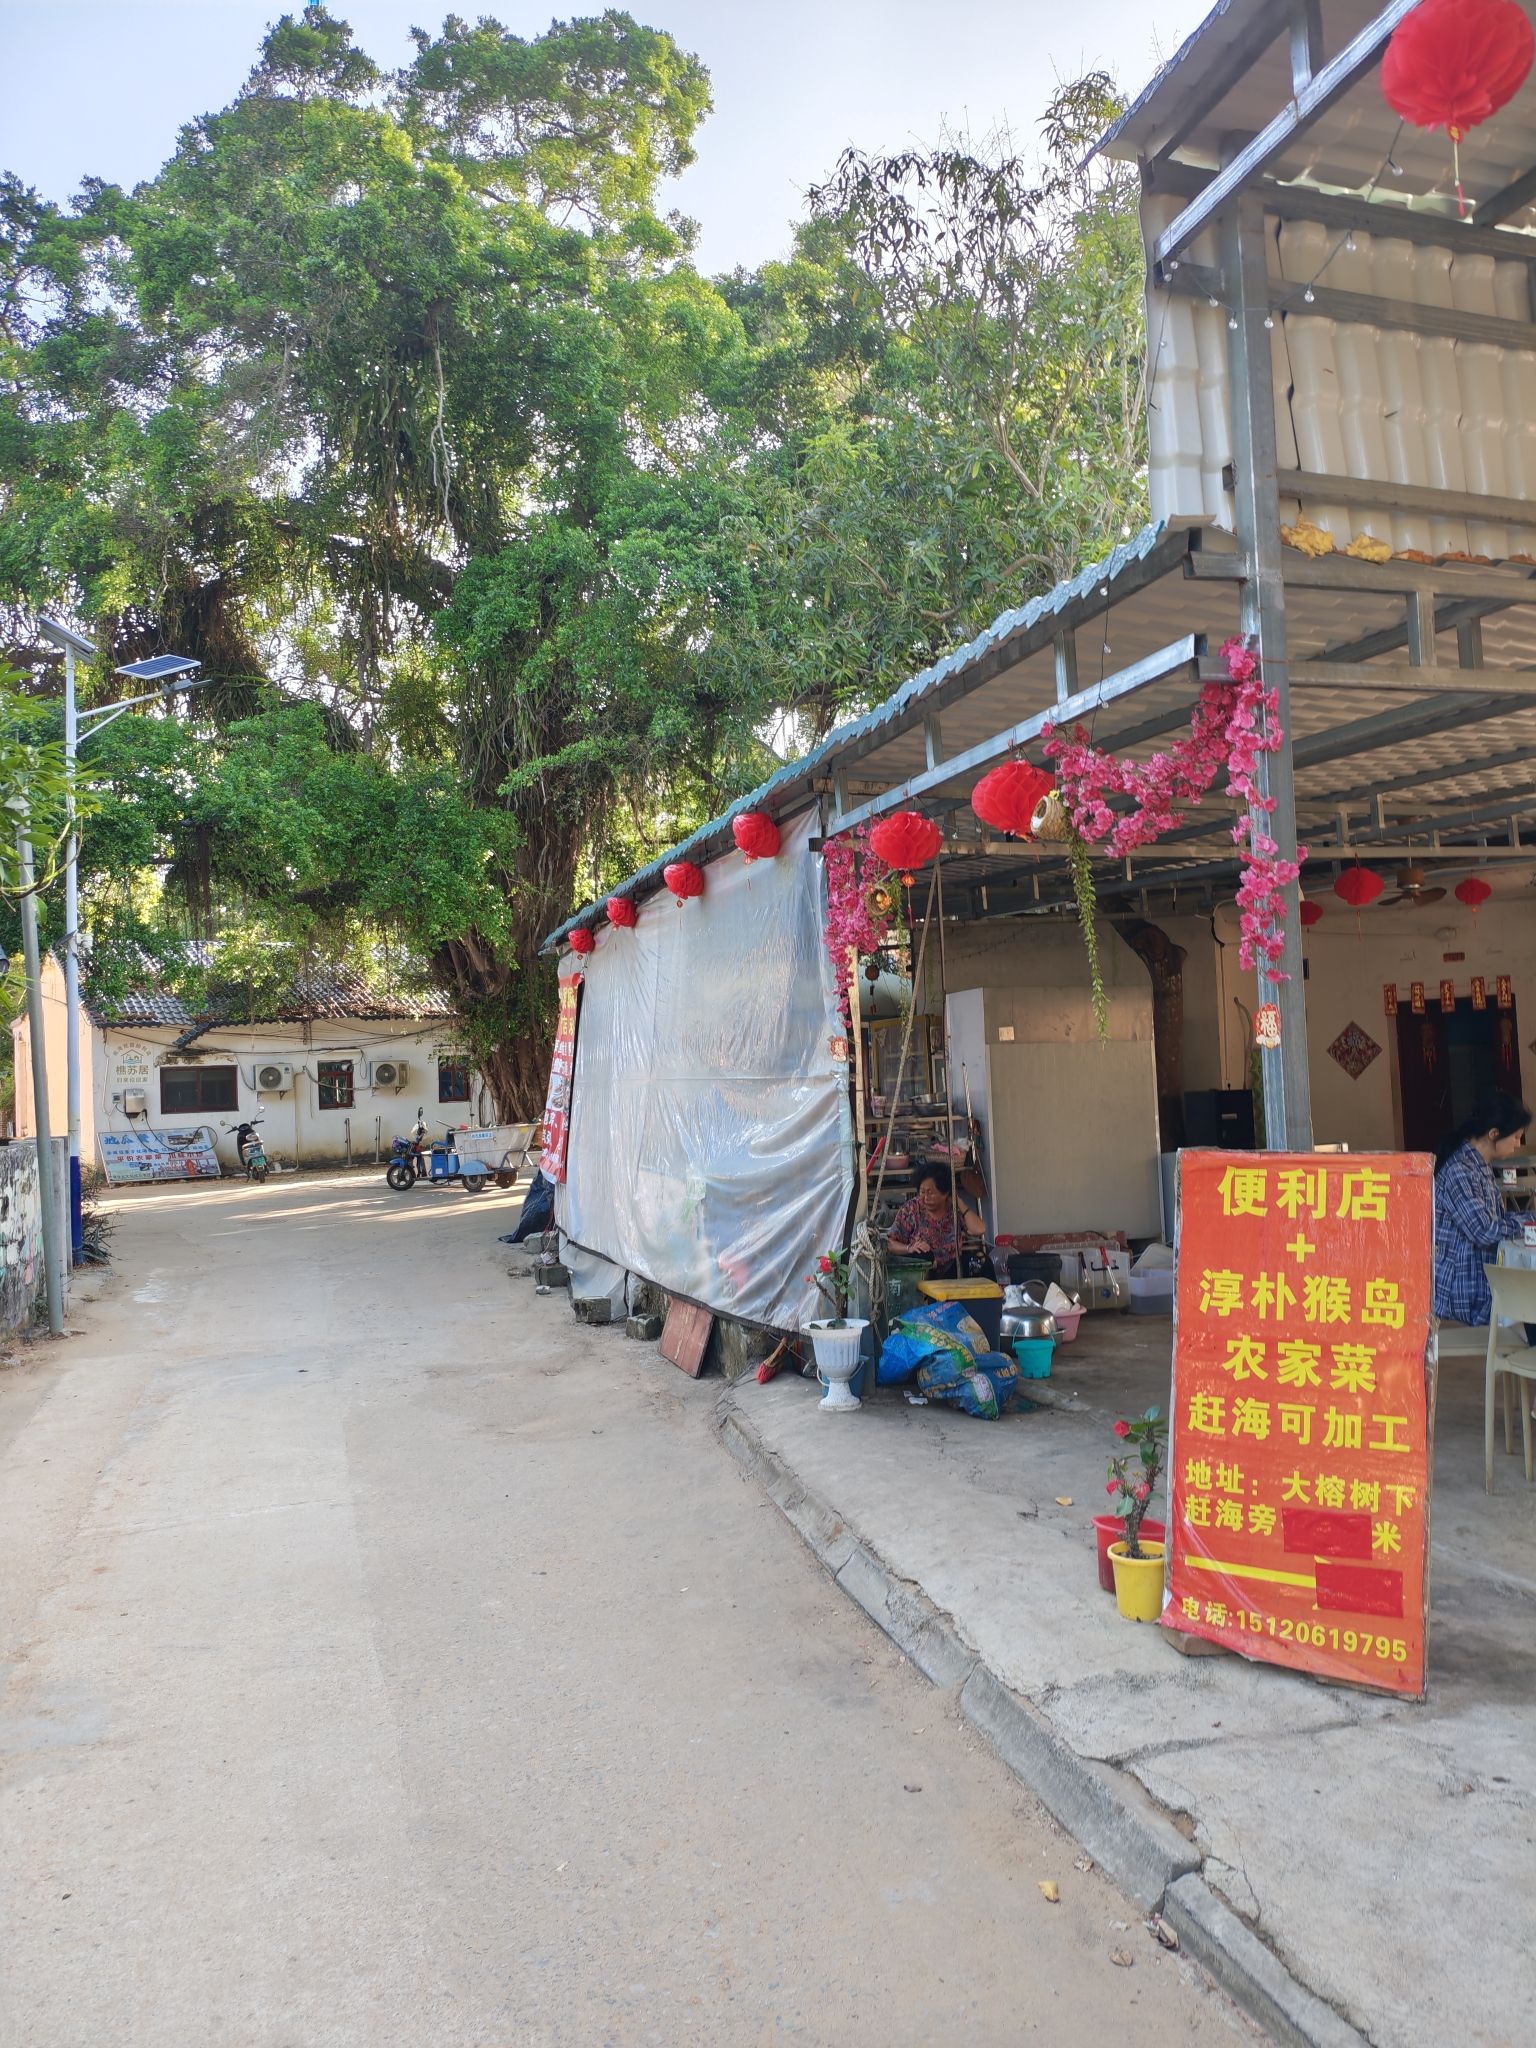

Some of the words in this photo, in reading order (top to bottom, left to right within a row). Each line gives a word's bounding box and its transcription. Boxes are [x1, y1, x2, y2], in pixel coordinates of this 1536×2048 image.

[1260, 1010, 1278, 1037] 福
[1217, 1165, 1391, 1222] 便利店
[1199, 1269, 1406, 1330] 淳朴猴岛
[1221, 1332, 1378, 1394] 农家菜
[1187, 1391, 1411, 1453] 赶海可加工
